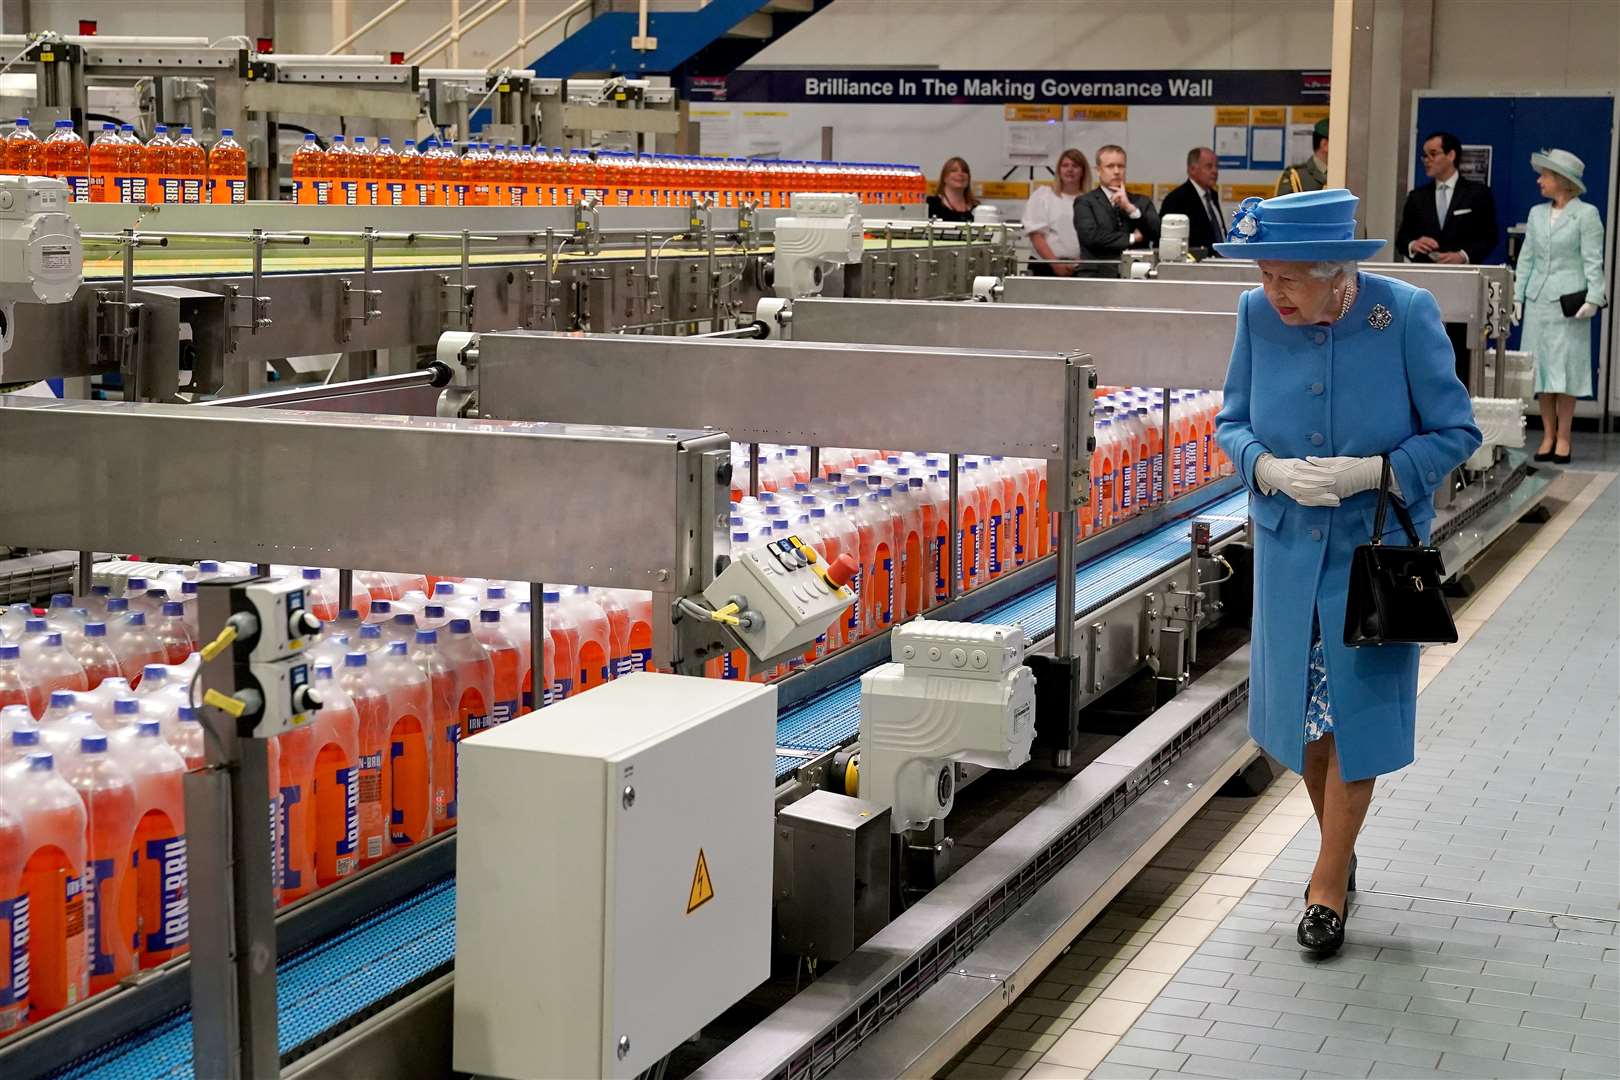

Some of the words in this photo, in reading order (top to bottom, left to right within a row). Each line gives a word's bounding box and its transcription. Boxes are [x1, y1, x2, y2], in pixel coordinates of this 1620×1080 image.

[805, 78, 893, 96] Brilliance
[899, 78, 916, 96] In
[921, 78, 958, 96] The
[963, 78, 1035, 100] Making
[1041, 78, 1163, 97] Governance
[1168, 79, 1213, 97] Wall
[165, 839, 189, 945] IRN-BRU
